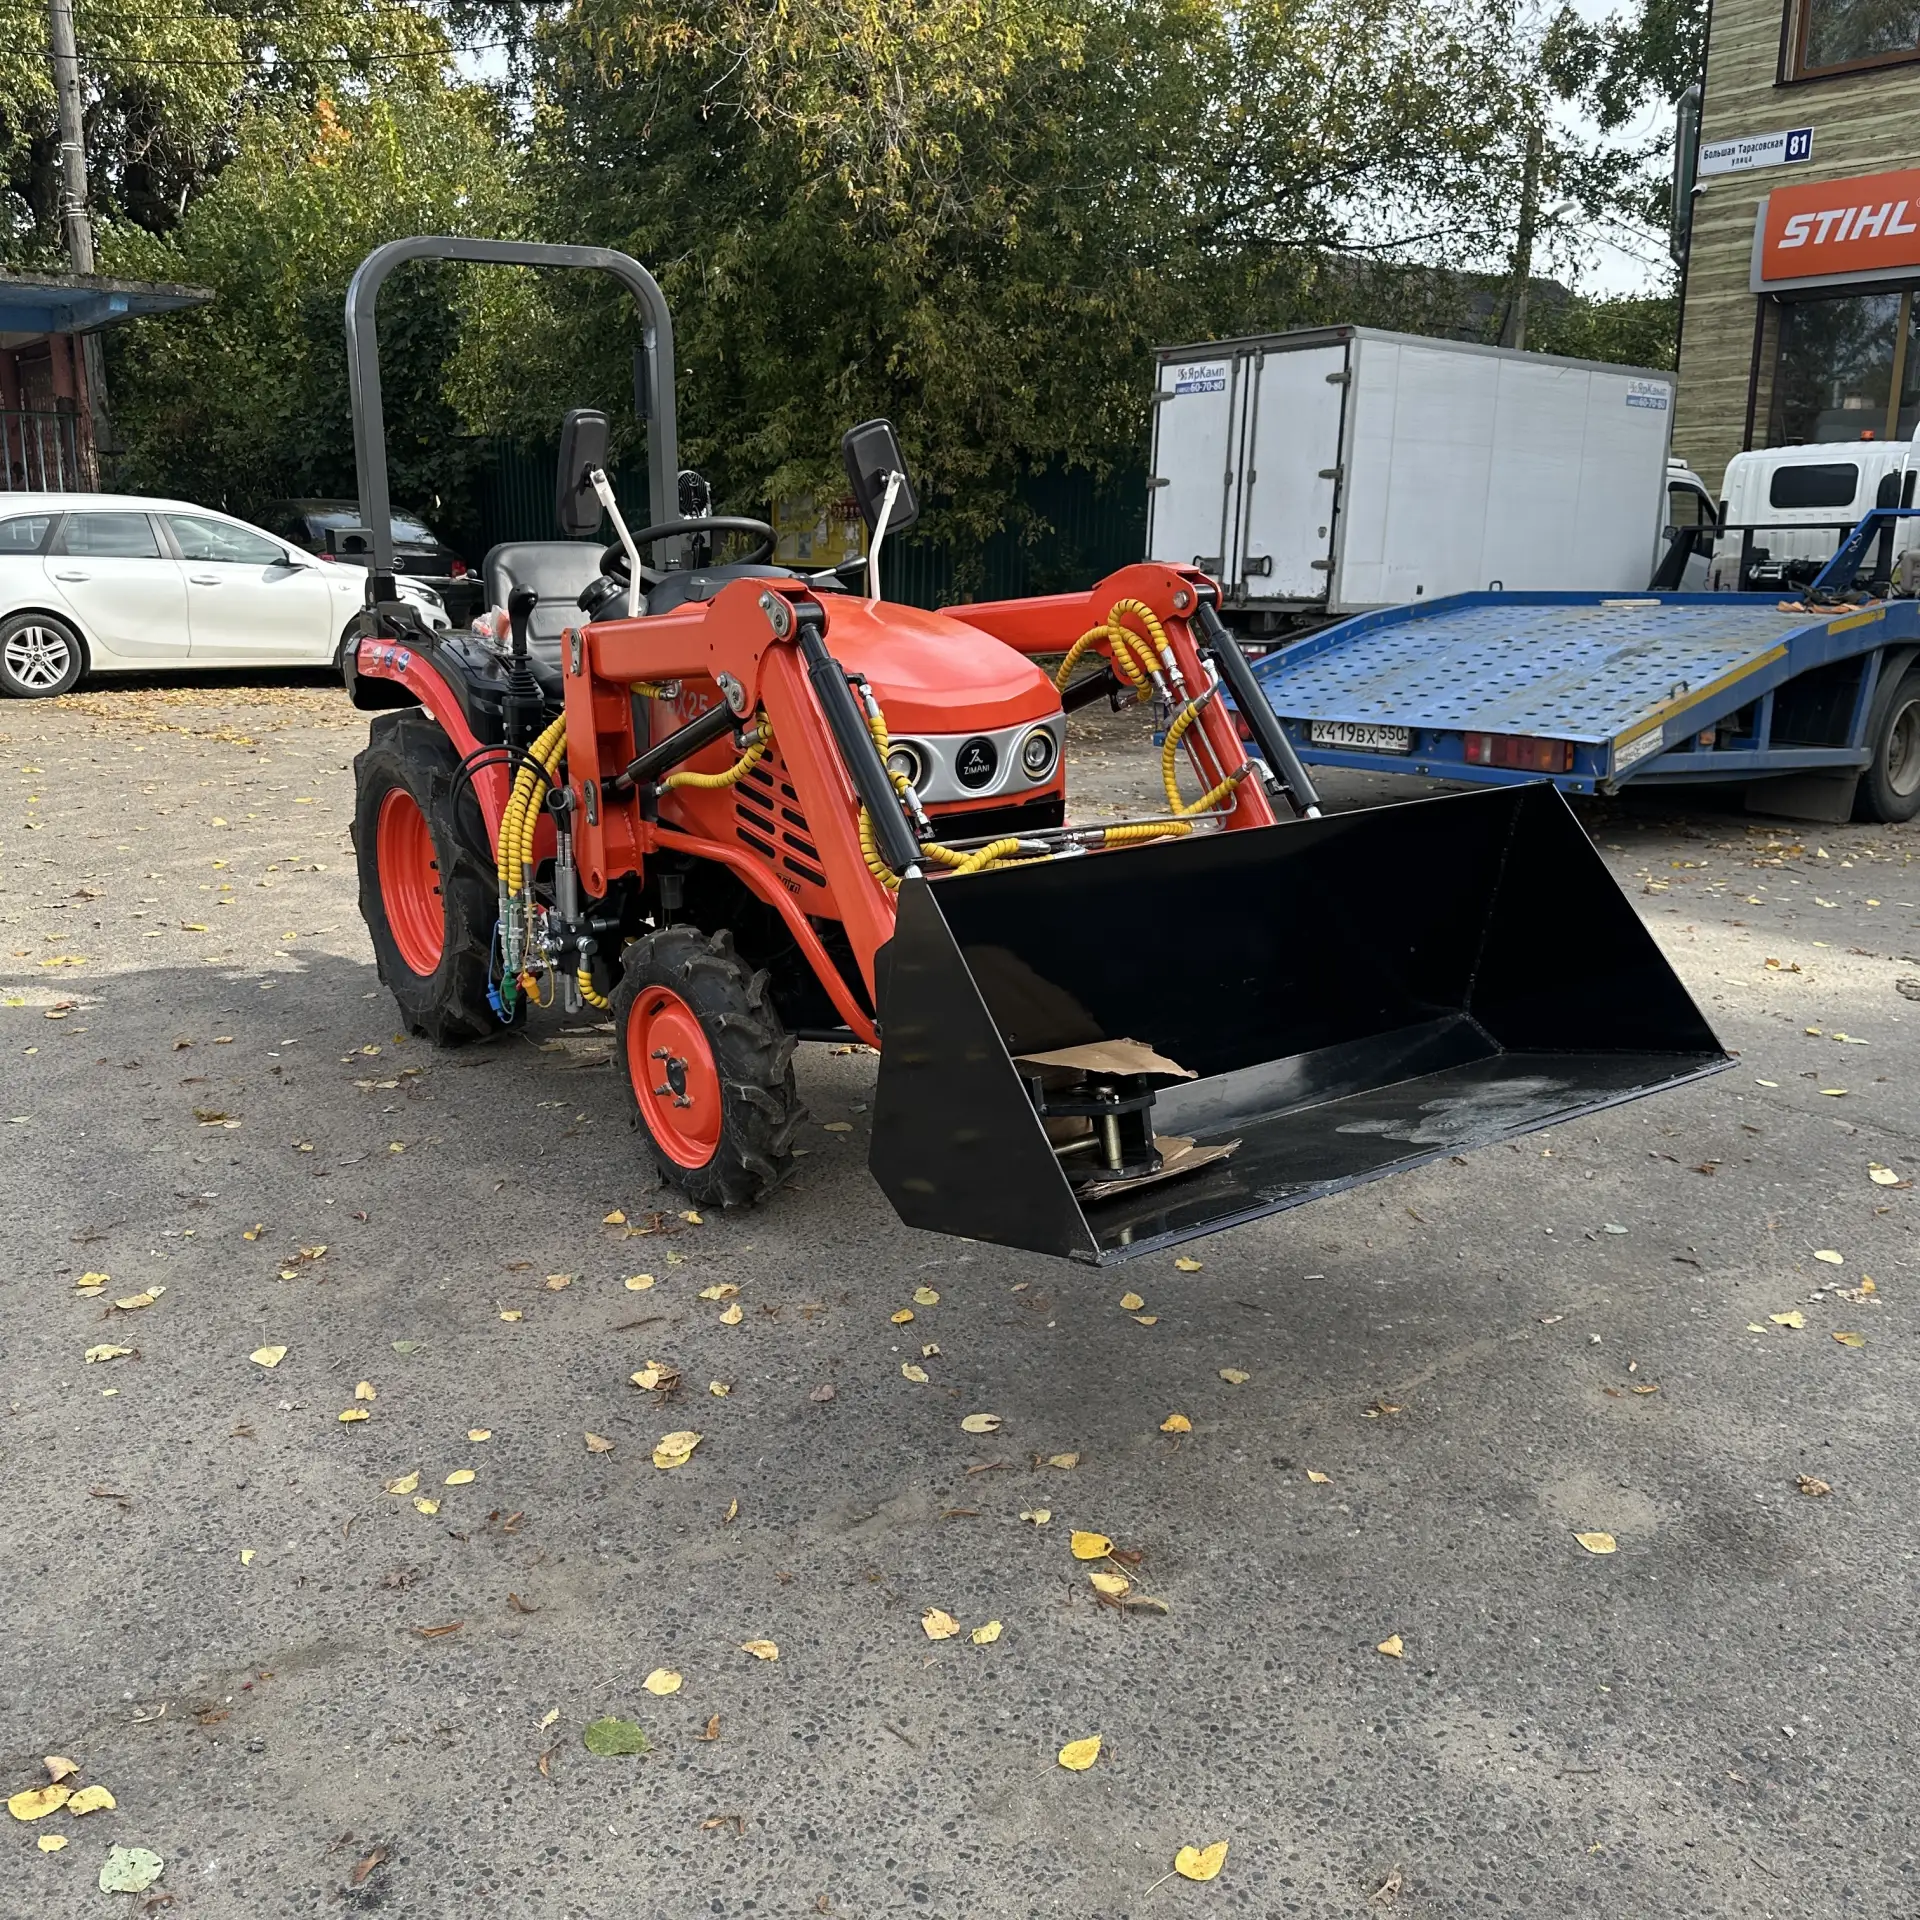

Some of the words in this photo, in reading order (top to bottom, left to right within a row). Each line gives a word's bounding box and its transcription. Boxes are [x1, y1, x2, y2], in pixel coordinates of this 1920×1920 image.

[1703, 146, 1736, 160] Большая
[1738, 139, 1784, 157] Тарасовская
[1789, 134, 1808, 156] 81
[1731, 155, 1752, 167] улица
[1777, 200, 1917, 249] STIHL
[1379, 726, 1404, 742] 550
[963, 764, 990, 775] ZIMANI
